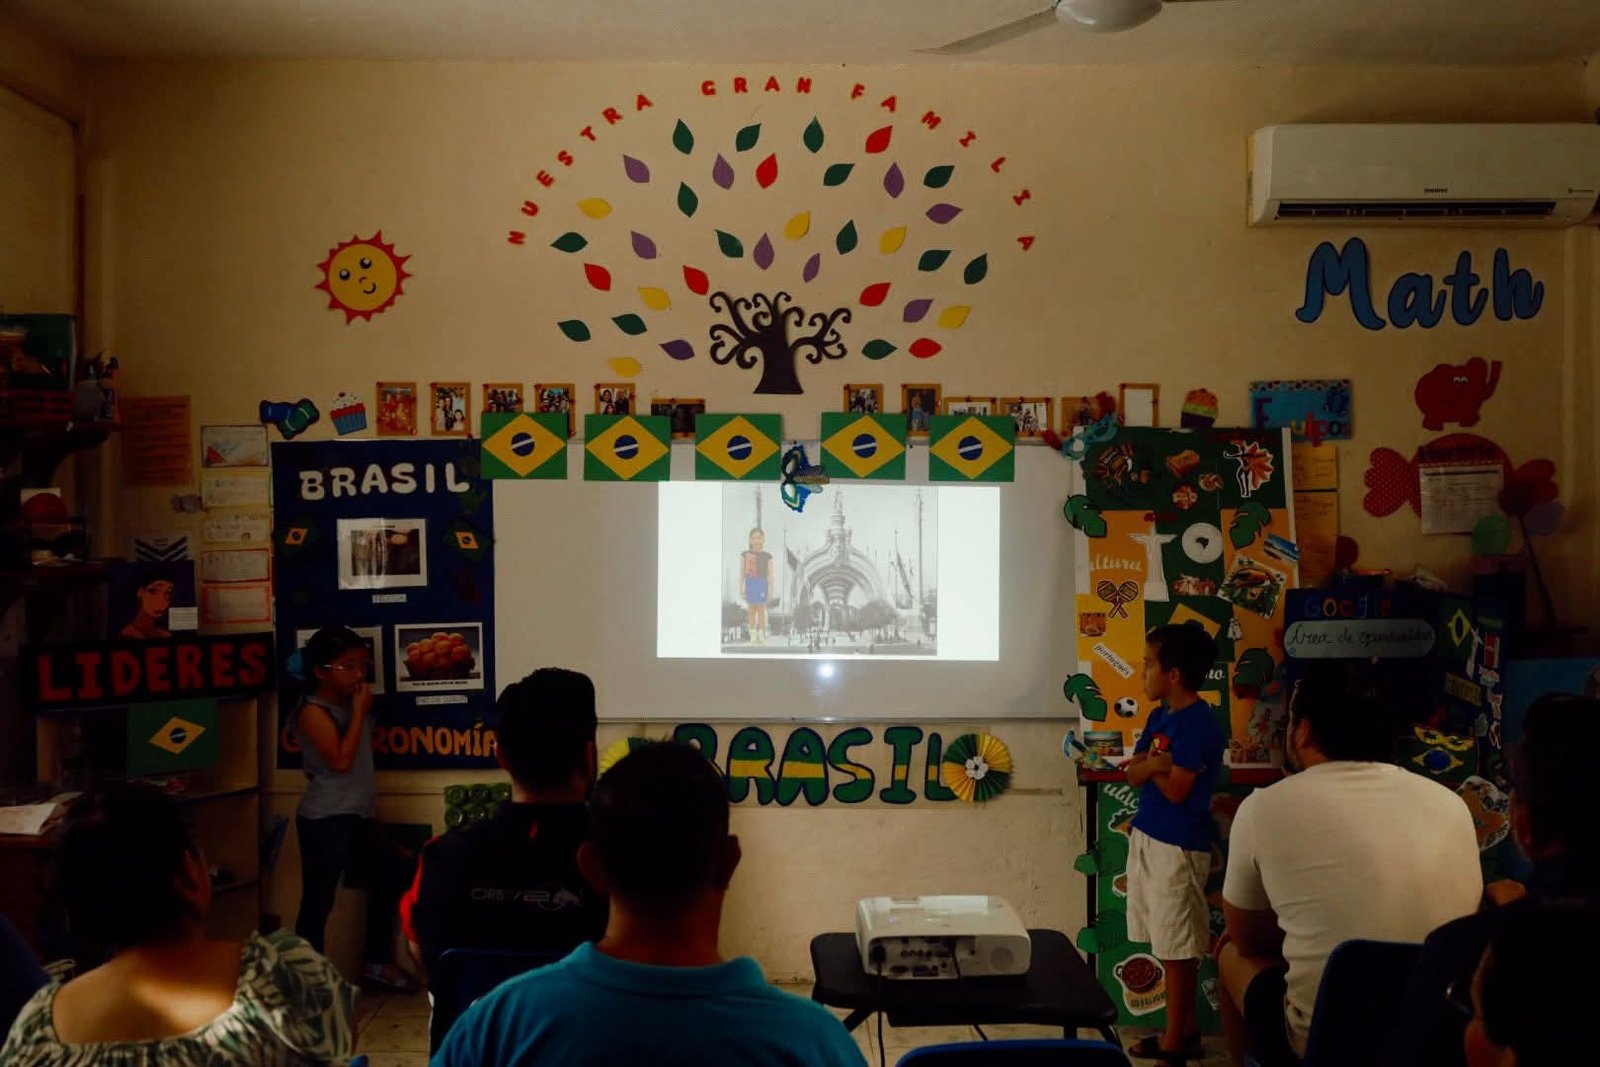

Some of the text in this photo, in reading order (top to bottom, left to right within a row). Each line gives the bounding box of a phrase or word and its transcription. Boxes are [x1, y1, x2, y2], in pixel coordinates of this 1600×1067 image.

[507, 75, 1036, 251] NUESTRA GRAN FAMILIA
[1296, 237, 1545, 330] Math
[297, 461, 471, 502] BRASIL
[36, 642, 268, 703] LIDERES
